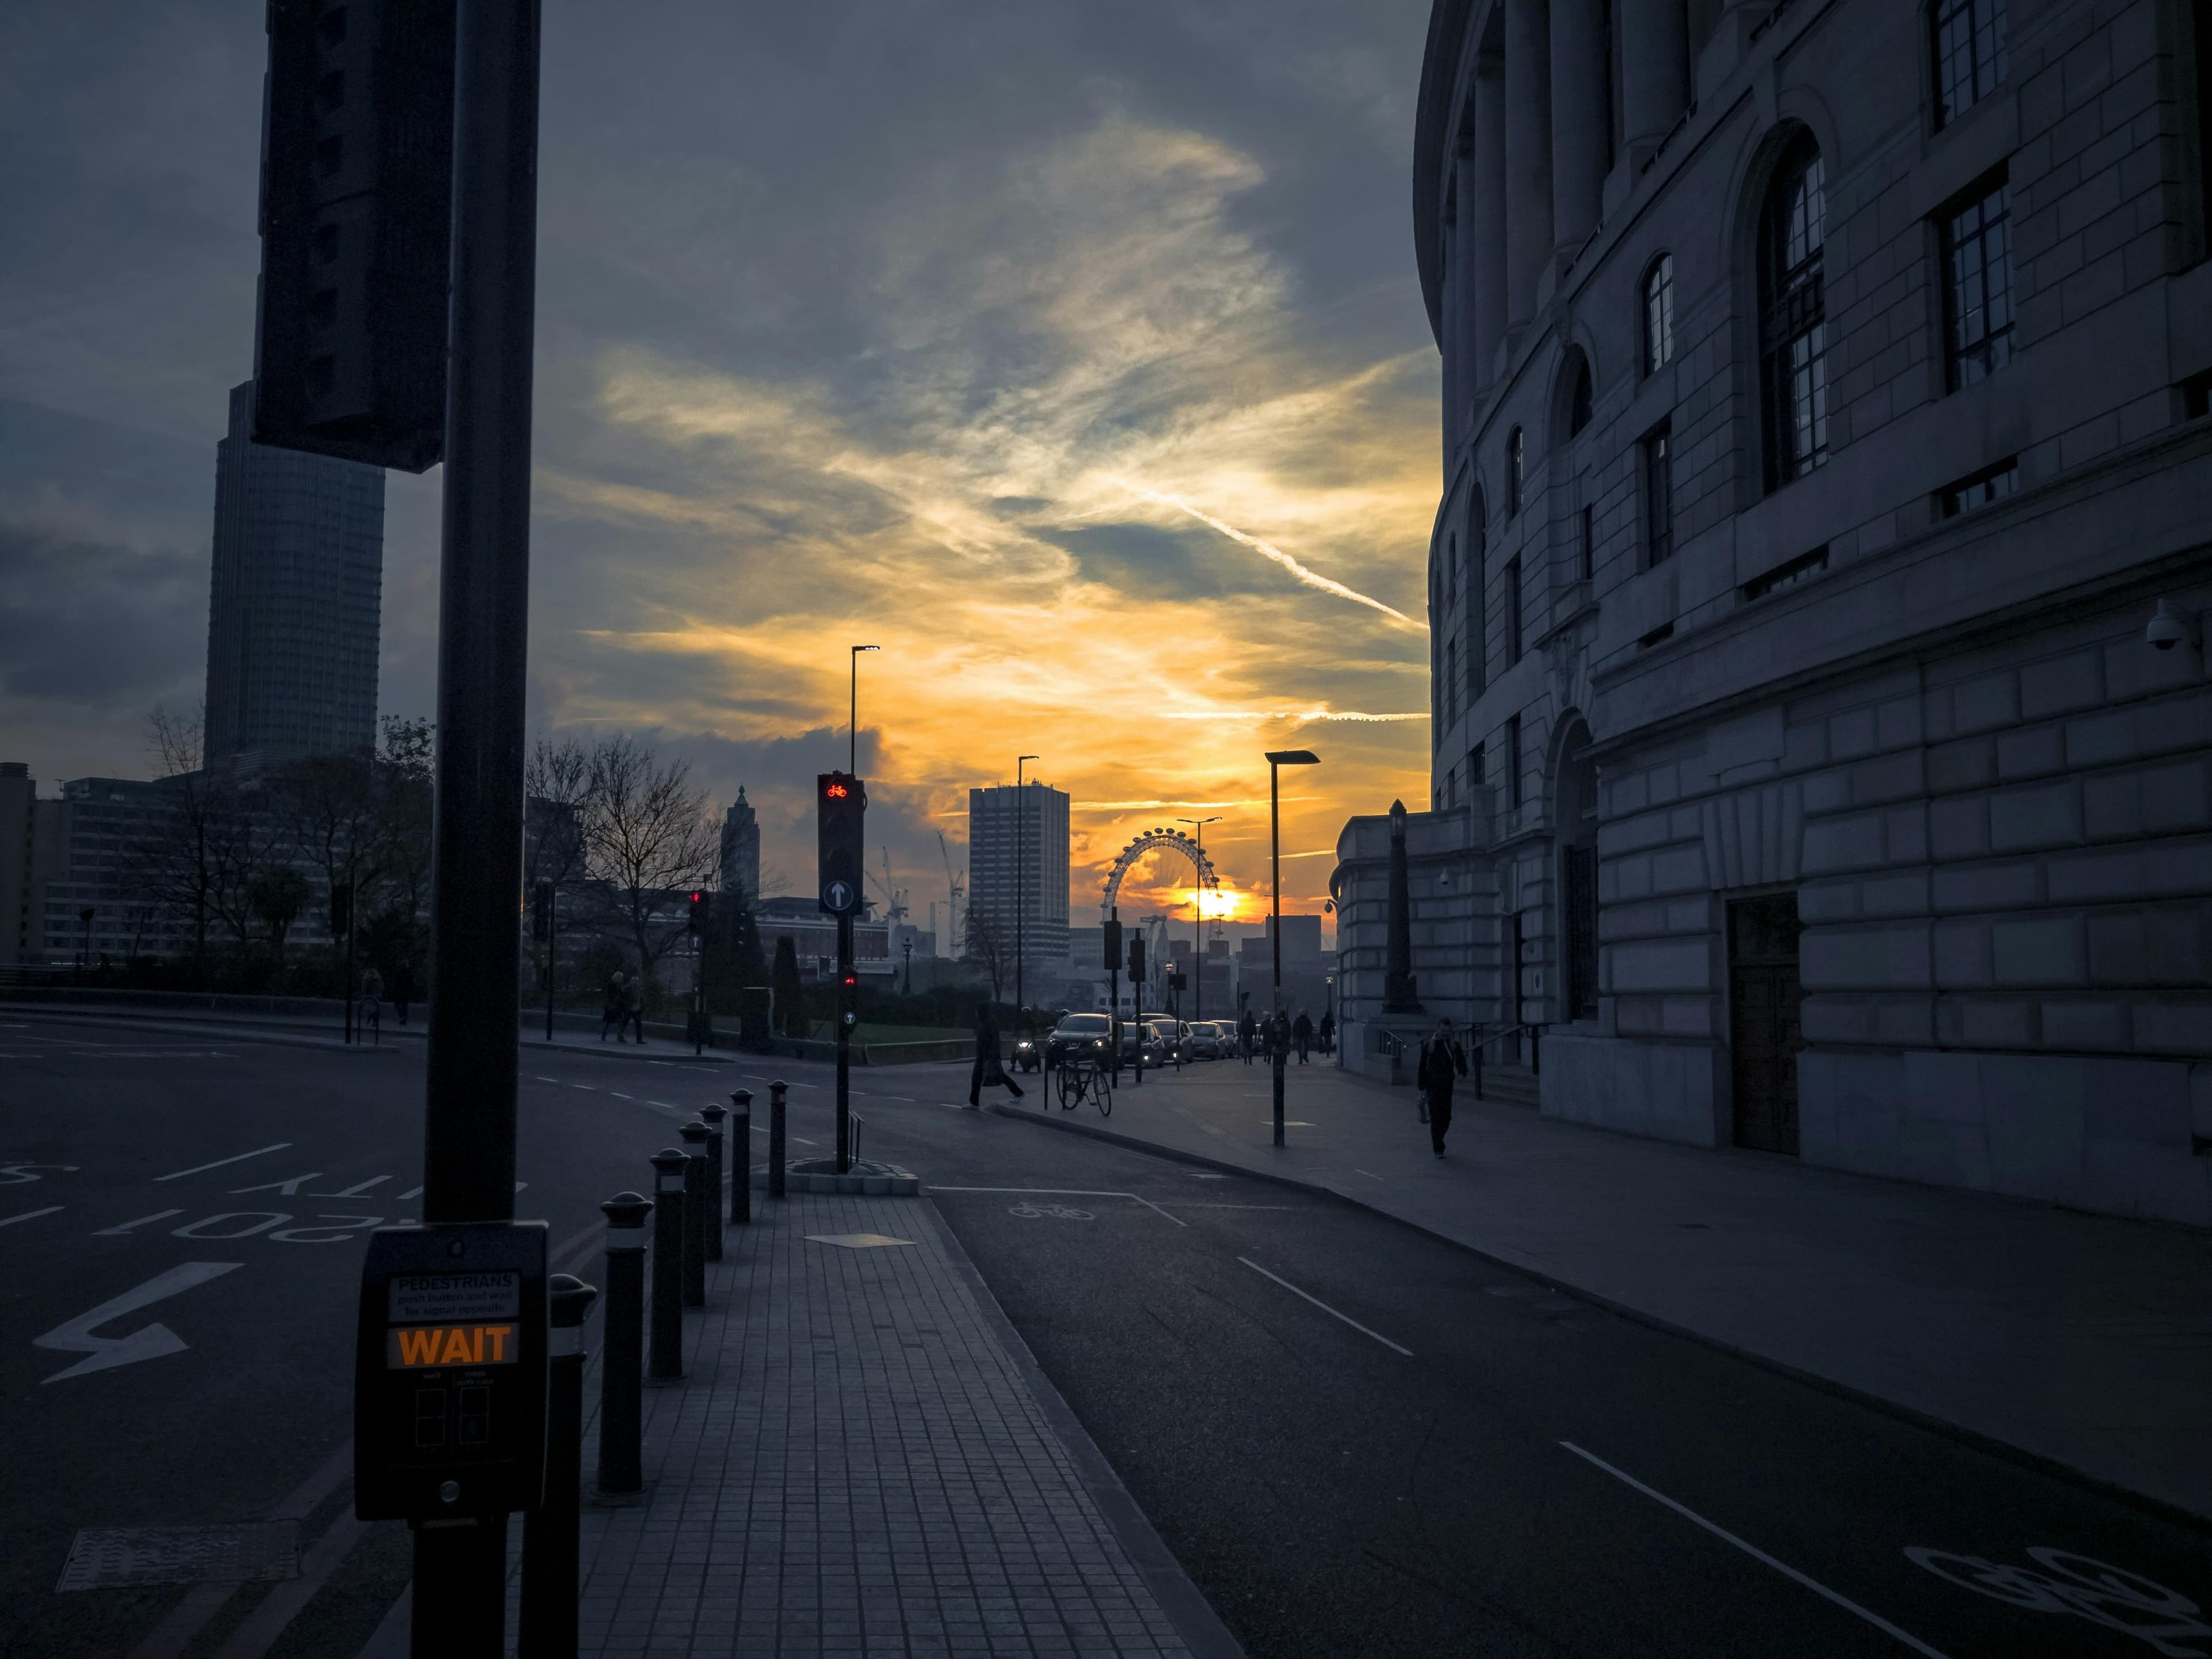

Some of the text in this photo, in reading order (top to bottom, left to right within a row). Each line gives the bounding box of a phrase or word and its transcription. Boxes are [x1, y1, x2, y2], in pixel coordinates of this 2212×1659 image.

[91, 1209, 416, 1243] 201
[399, 1274, 513, 1291] PEDESTRIANS
[398, 1291, 513, 1305] push button and wait
[405, 1304, 506, 1316] for signal opposite
[397, 1326, 512, 1366] WAIT
